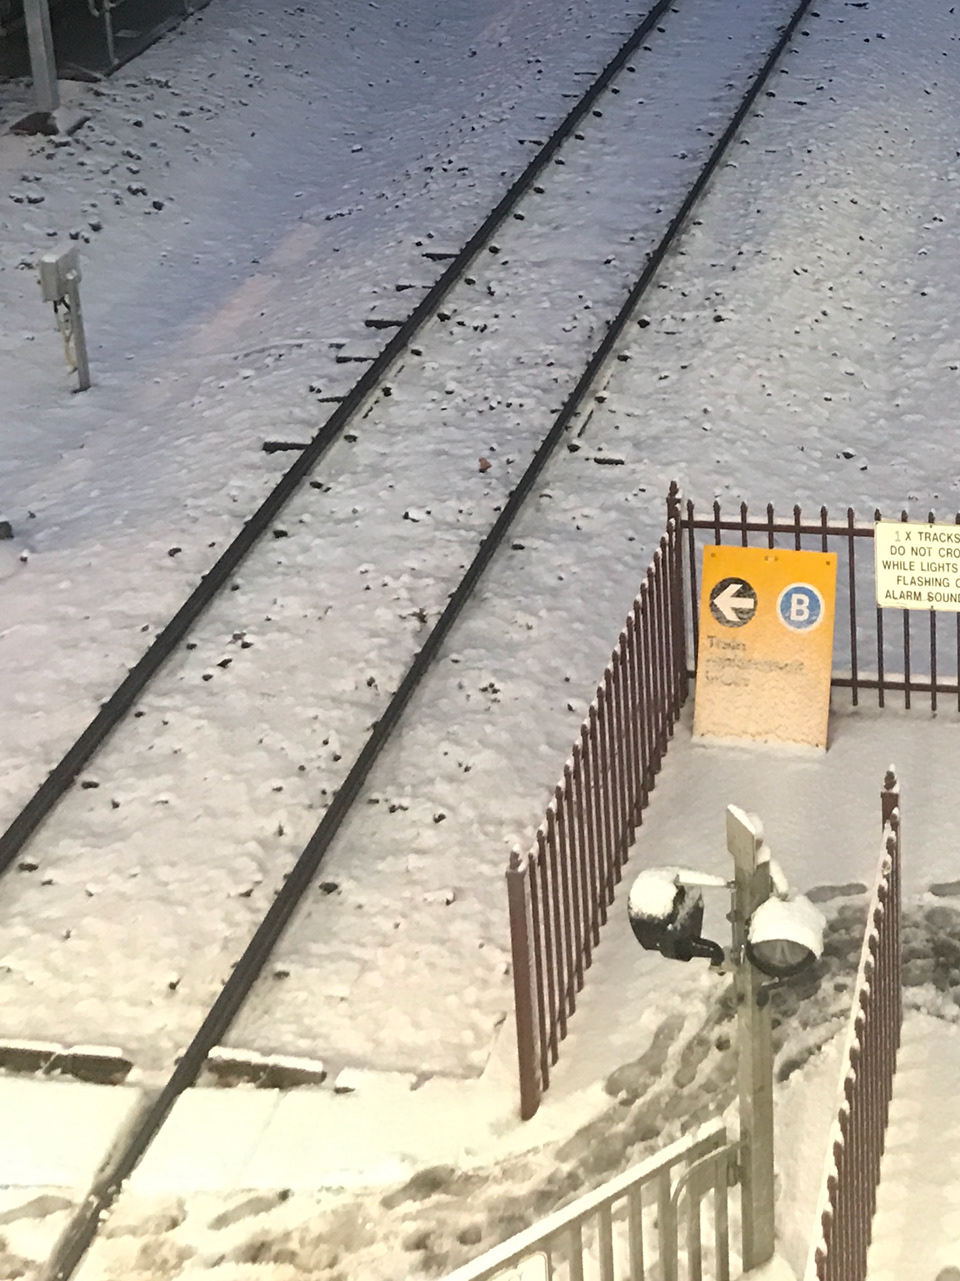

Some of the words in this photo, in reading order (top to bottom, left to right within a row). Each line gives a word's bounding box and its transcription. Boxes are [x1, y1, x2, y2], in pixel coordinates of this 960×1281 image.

[906, 531, 911, 541] X
[918, 532, 960, 543] TRACKS
[891, 546, 905, 556] DO
[911, 547, 932, 556] NOT
[882, 561, 915, 571] WHILE
[921, 562, 958, 573] LIGHTS
[897, 576, 949, 587] FLASHING
[885, 590, 922, 600] ALARM
[790, 594, 809, 621] B
